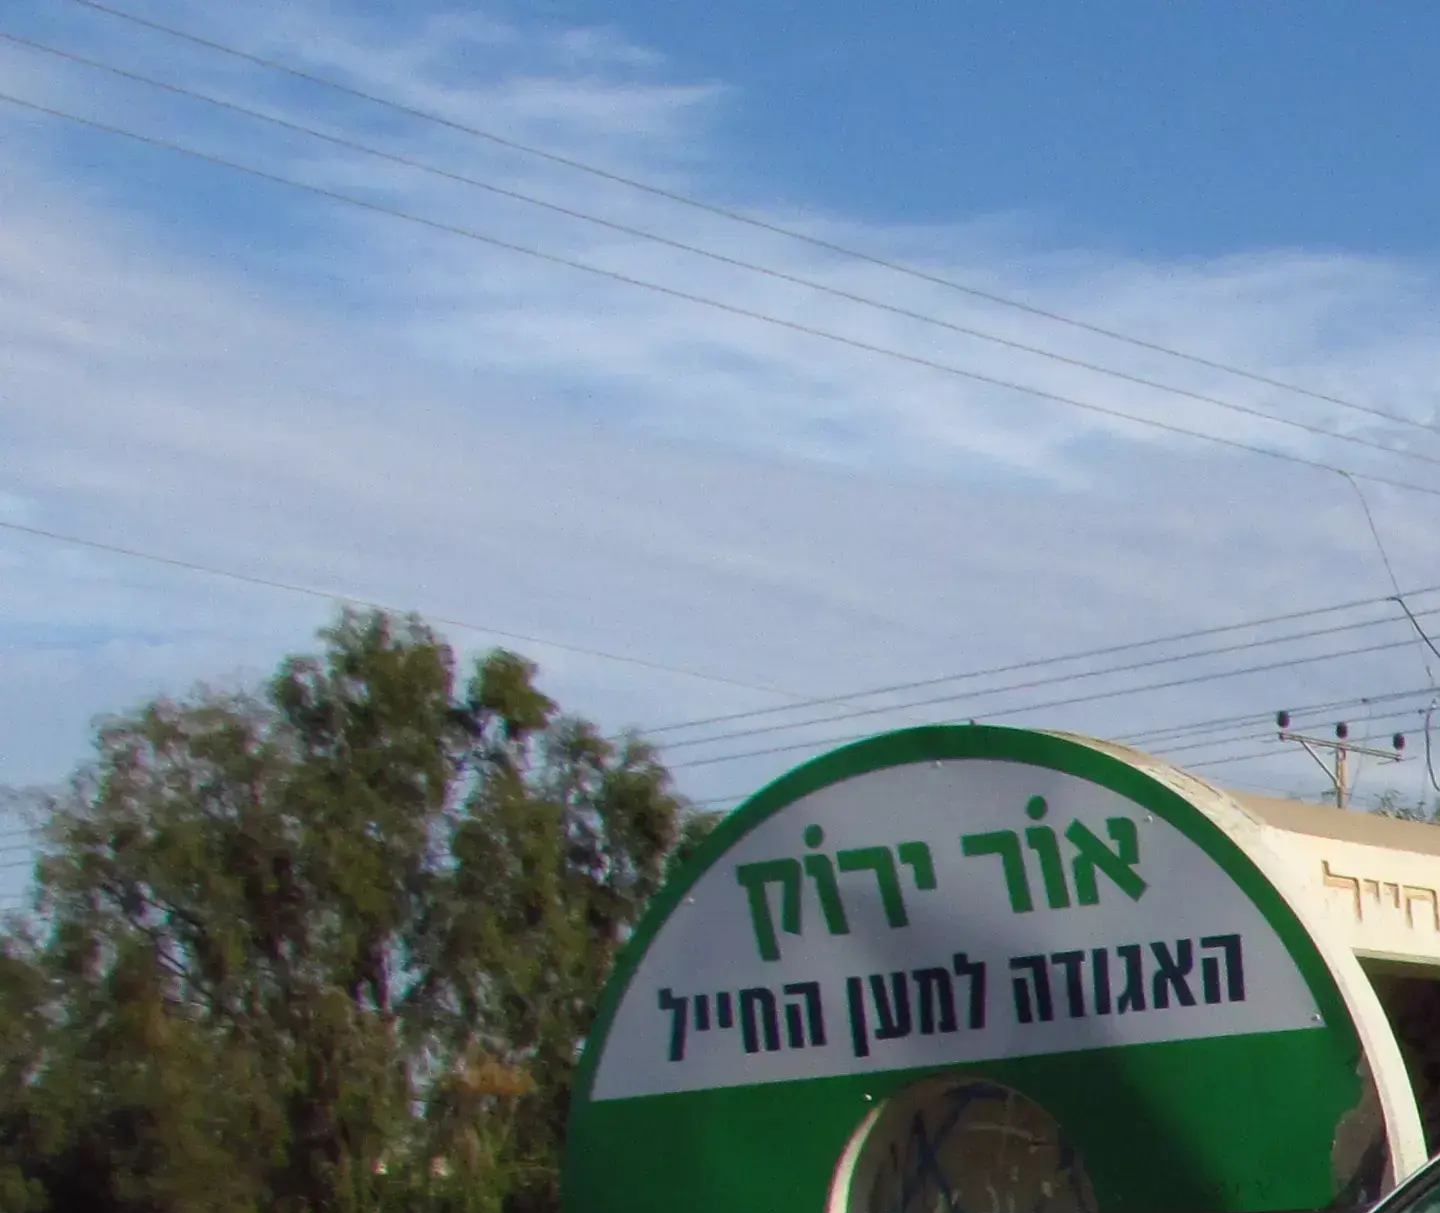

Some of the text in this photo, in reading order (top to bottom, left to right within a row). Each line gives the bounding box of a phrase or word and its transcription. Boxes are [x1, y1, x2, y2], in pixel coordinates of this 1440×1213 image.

[657, 933, 1245, 1064] האגודה למען החייל
